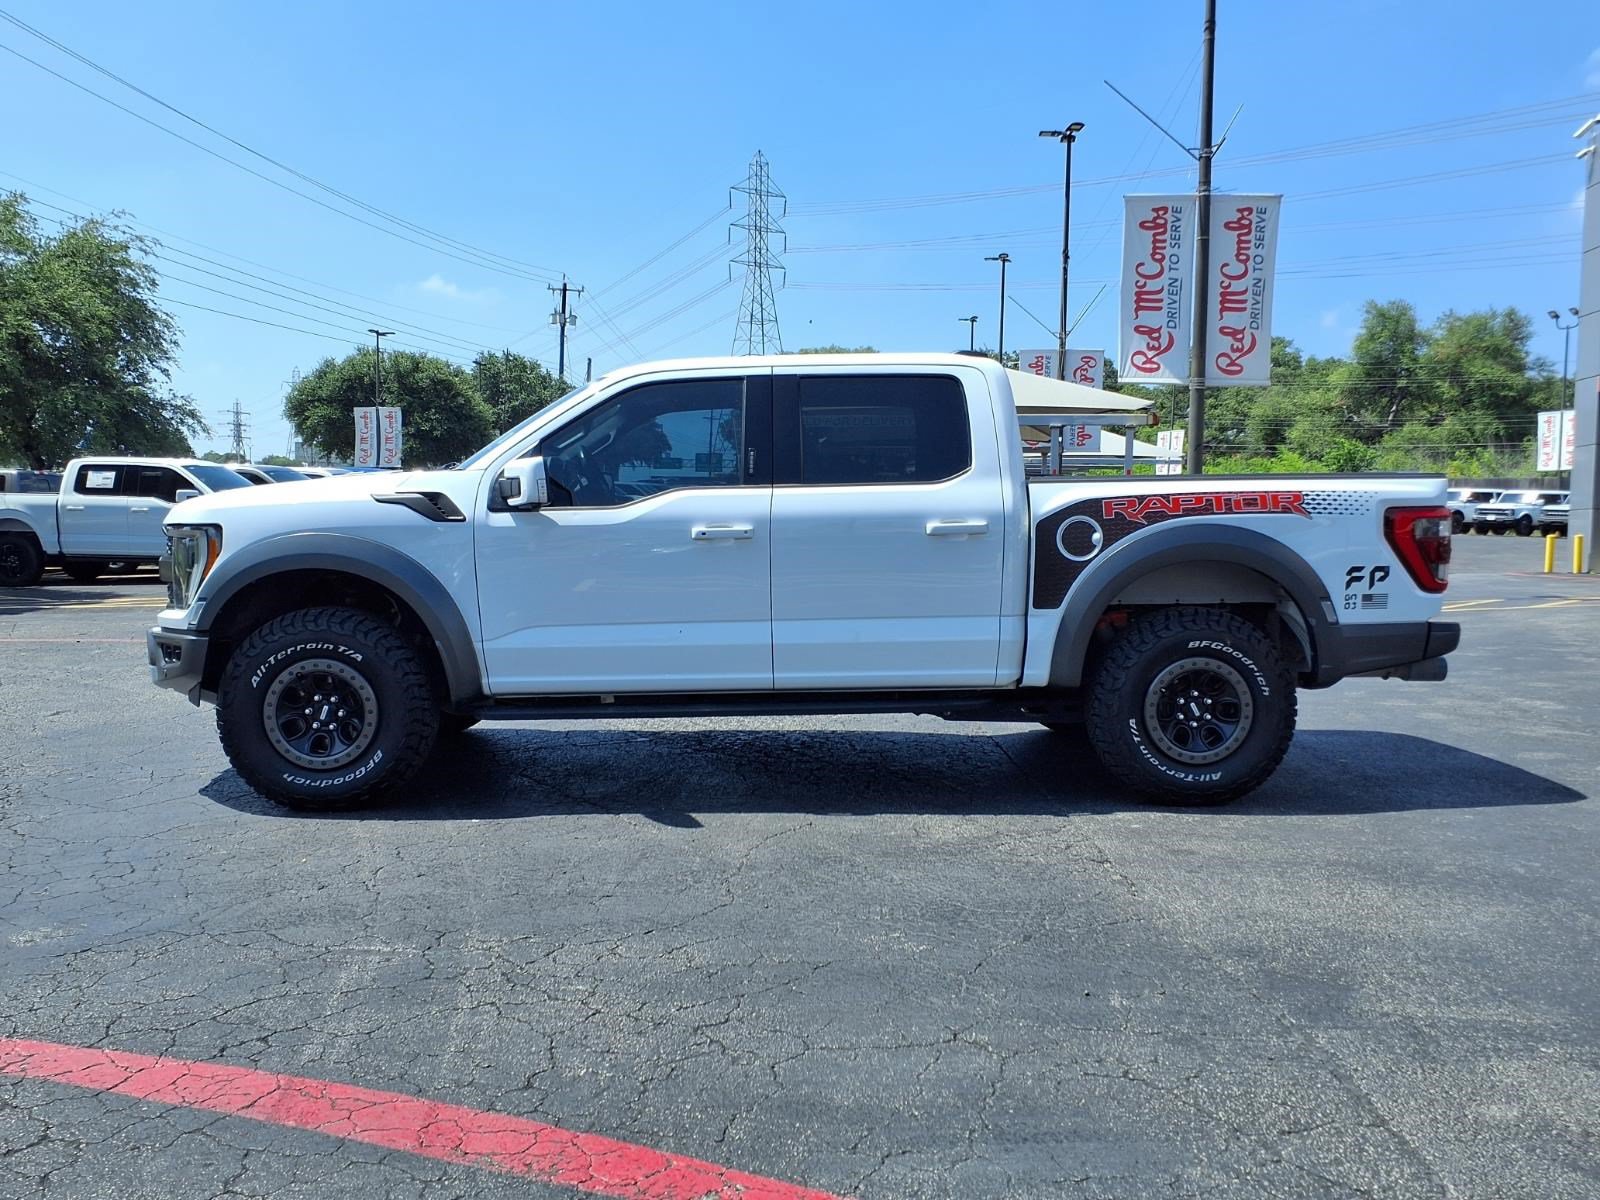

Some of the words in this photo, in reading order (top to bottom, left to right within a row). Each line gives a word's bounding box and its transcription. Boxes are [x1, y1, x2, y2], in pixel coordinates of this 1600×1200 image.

[1170, 205, 1183, 249] SERVE
[1254, 206, 1267, 249] SERVE
[1133, 206, 1169, 320] McCombs
[1168, 254, 1180, 274] TO
[1219, 206, 1254, 321] McCombs
[1253, 254, 1264, 274] TO
[1167, 278, 1179, 329] DRIVEN
[1250, 278, 1262, 330] DRIVEN
[1131, 325, 1174, 373] Red
[1215, 326, 1257, 376] Red
[1102, 491, 1312, 523] RAPTOR
[1345, 566, 1390, 591] FP
[251, 641, 334, 688] All-Terrain
[336, 645, 364, 662] T/A
[1187, 640, 1270, 696] BFGoodrich
[283, 750, 383, 787] BFGoodrich
[1139, 745, 1223, 782] All-Terrain
